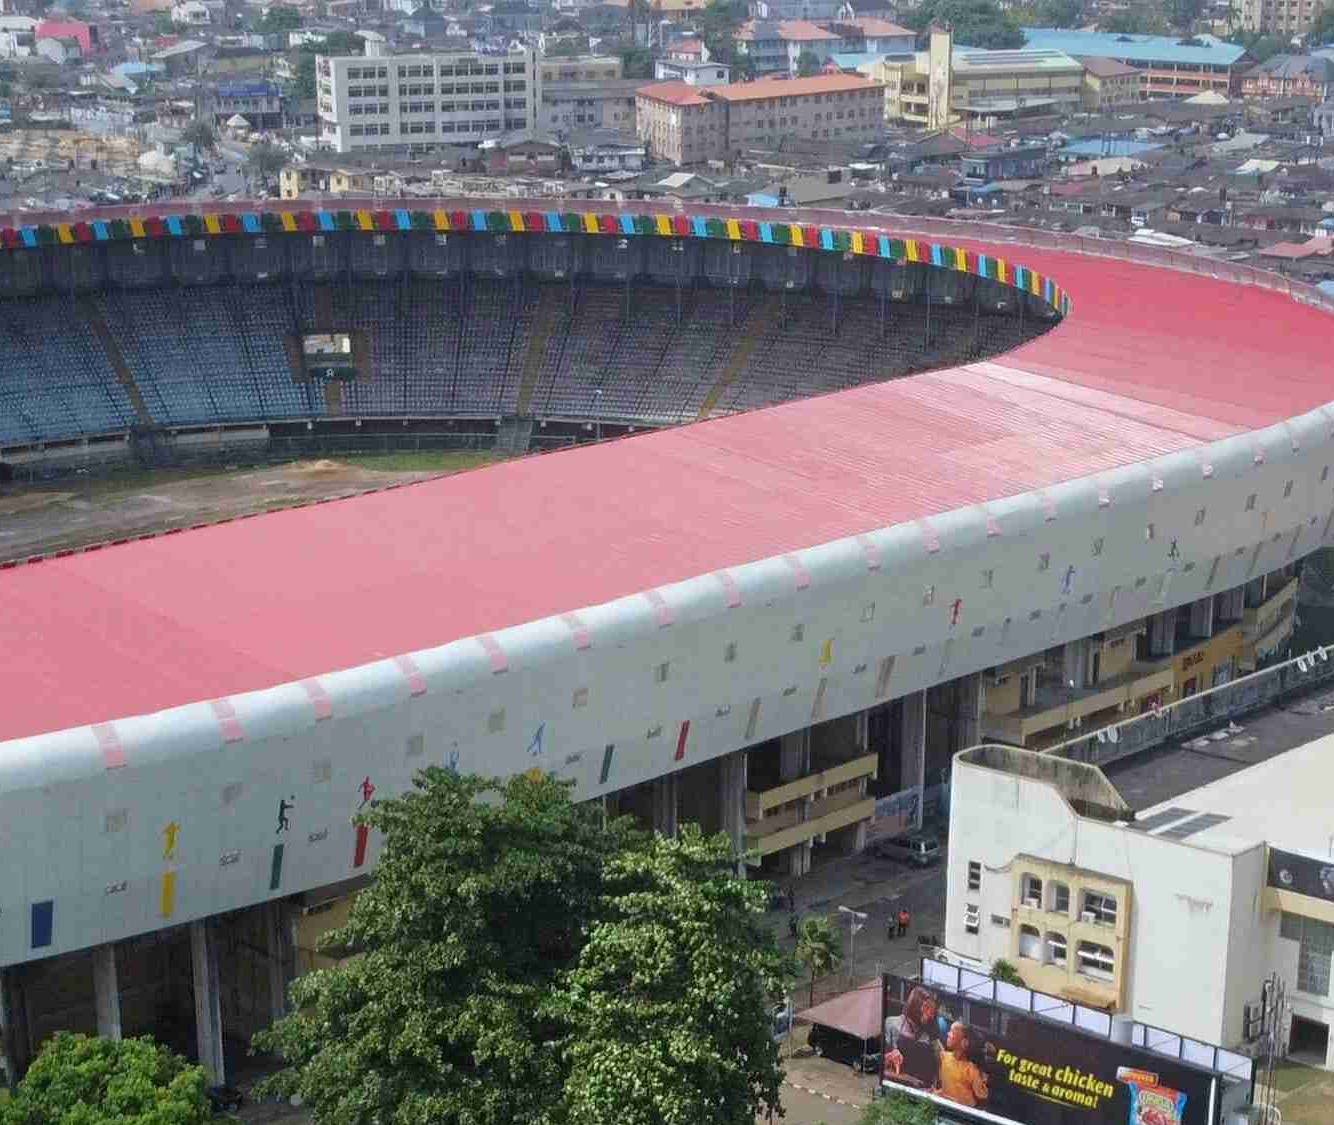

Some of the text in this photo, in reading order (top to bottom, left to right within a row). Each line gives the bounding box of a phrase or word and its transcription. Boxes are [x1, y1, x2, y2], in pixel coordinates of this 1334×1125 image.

[996, 1048, 1018, 1065] For
[1019, 1058, 1053, 1078] great
[1055, 1065, 1114, 1098] chicken
[1009, 1069, 1099, 1109] taste & aroma!
